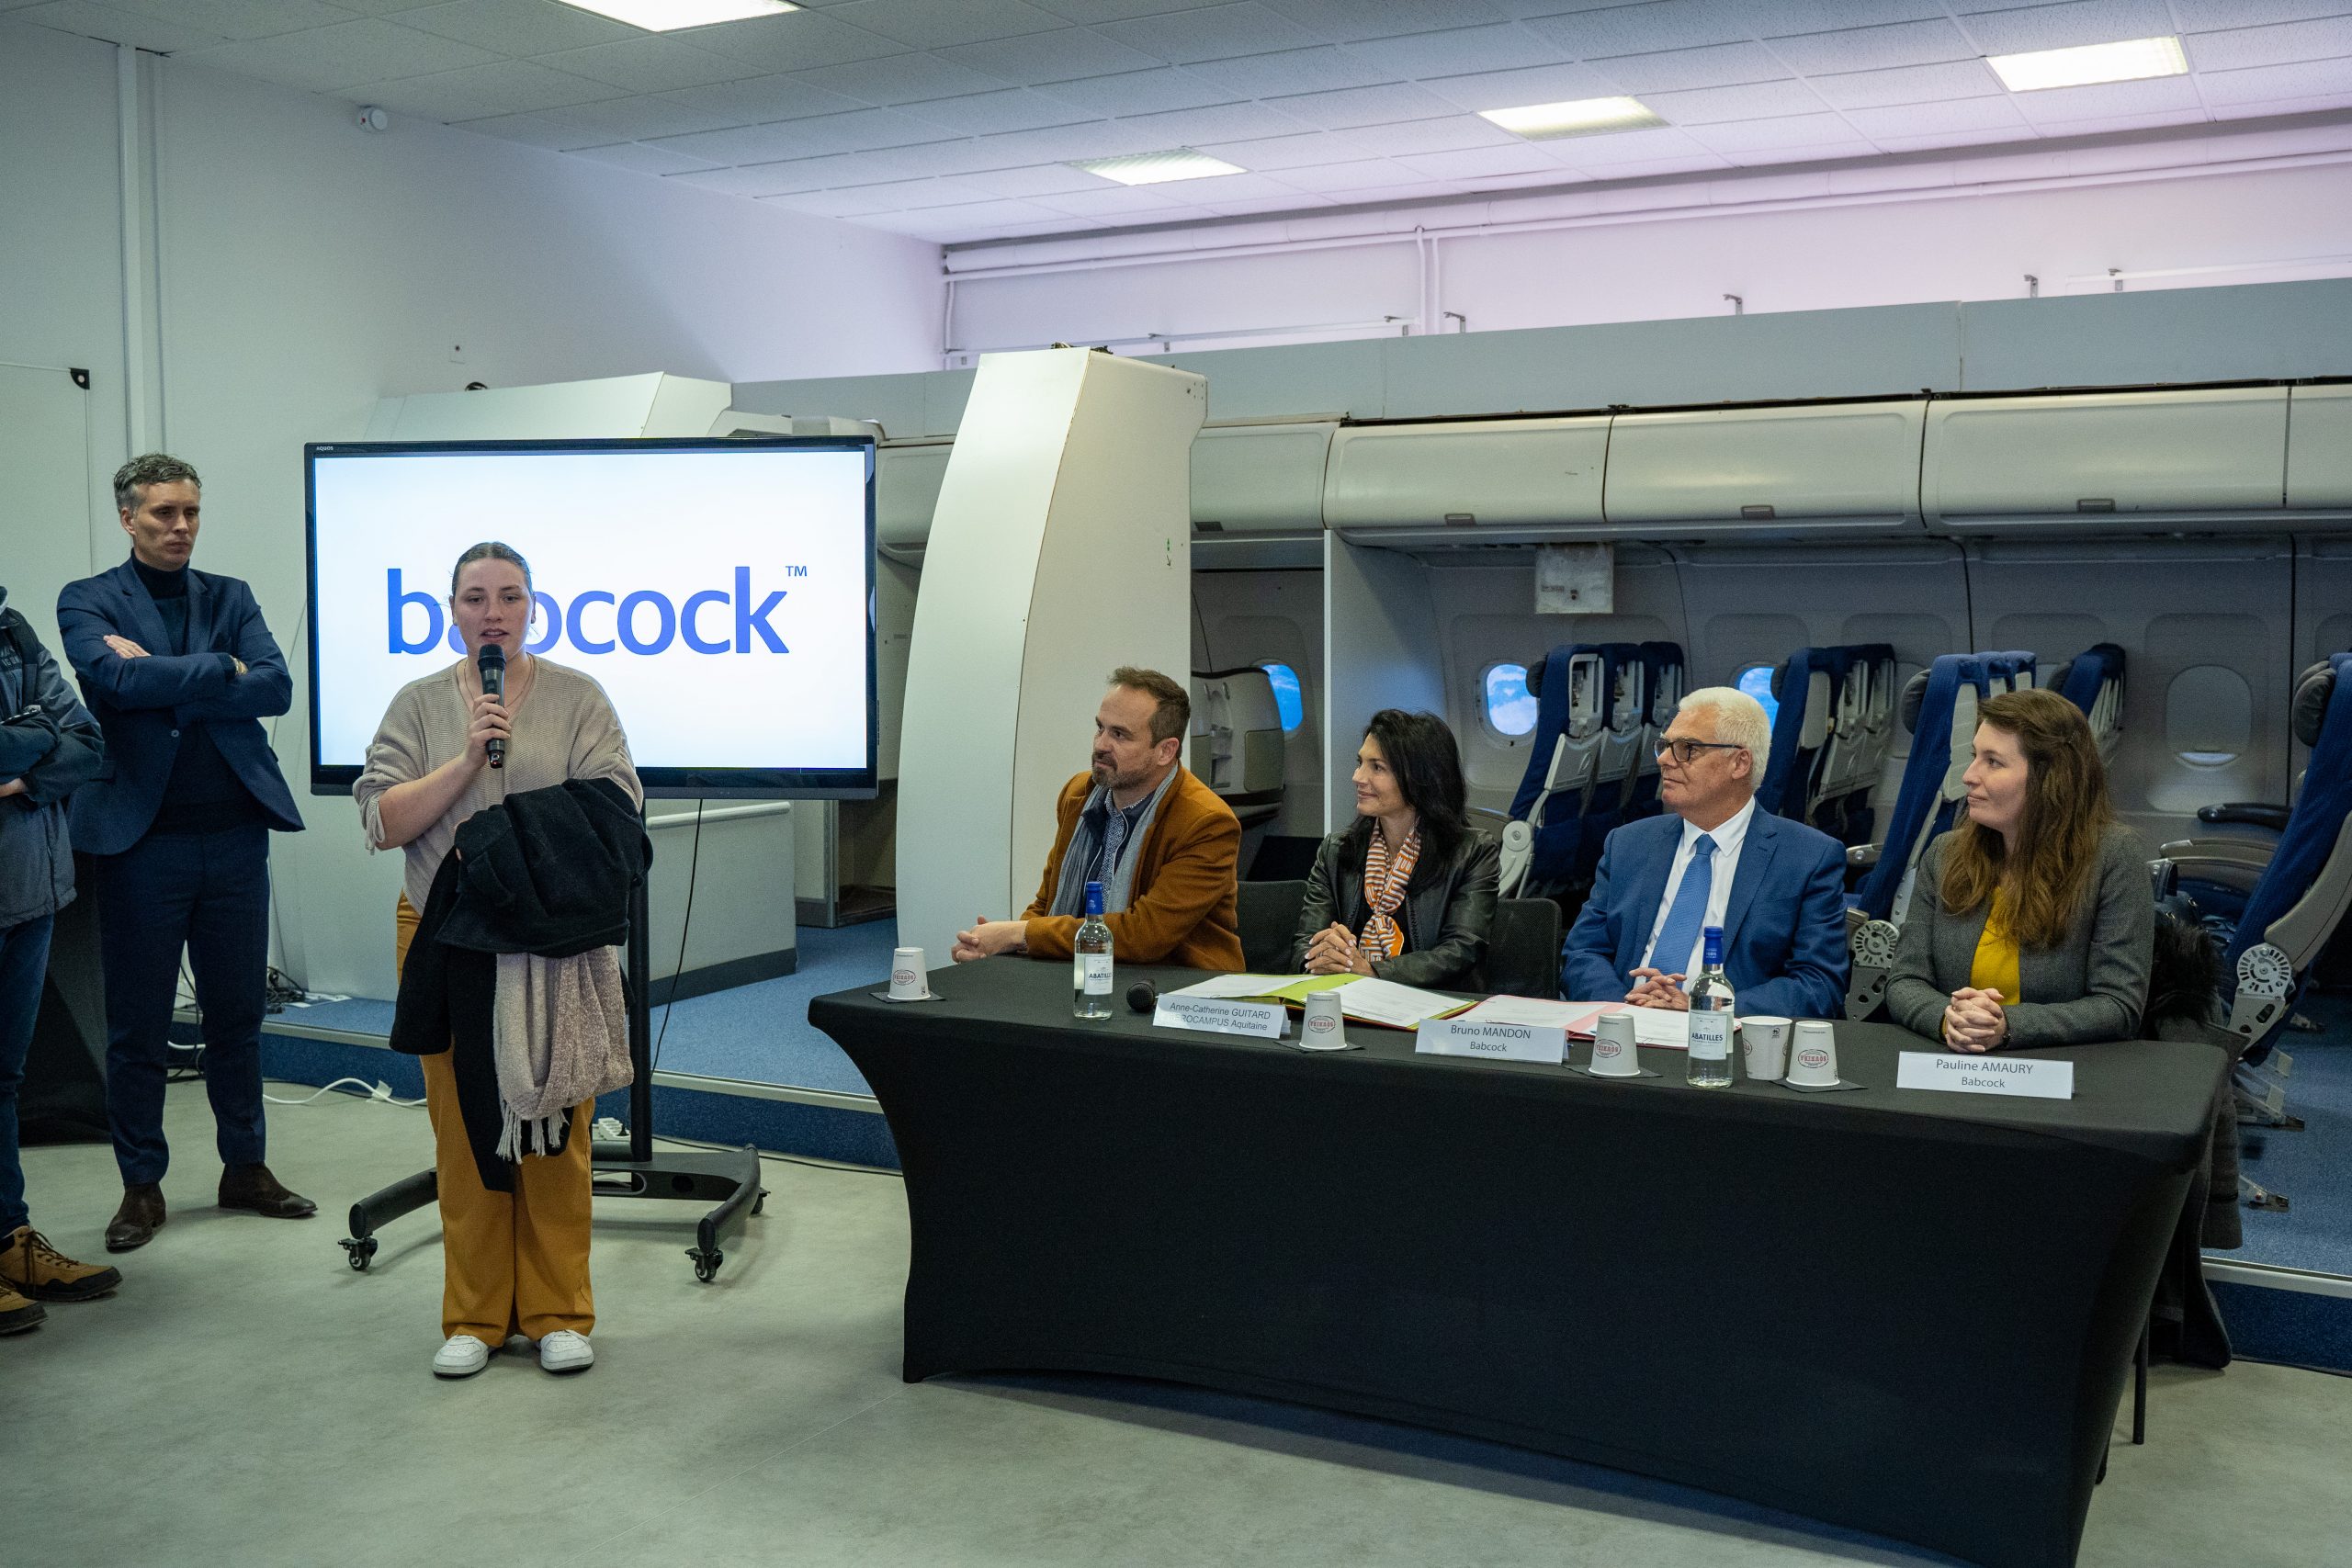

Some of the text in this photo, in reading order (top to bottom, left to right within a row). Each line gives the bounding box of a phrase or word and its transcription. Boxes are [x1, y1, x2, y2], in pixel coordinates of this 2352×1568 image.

[388, 565, 808, 656] bcock TM
[1170, 1002, 1271, 1020] Anne-Catherine GUITARD
[1170, 1012, 1268, 1031] EROCAMPUS Aquitaine
[1451, 1024, 1531, 1039] Bruno MANDON
[1691, 1032, 1724, 1041] ABATILLES
[1470, 1042, 1508, 1052] Babcock
[1936, 1059, 2033, 1074] Pauline AMAURY
[1962, 1077, 2005, 1089] Babcock
